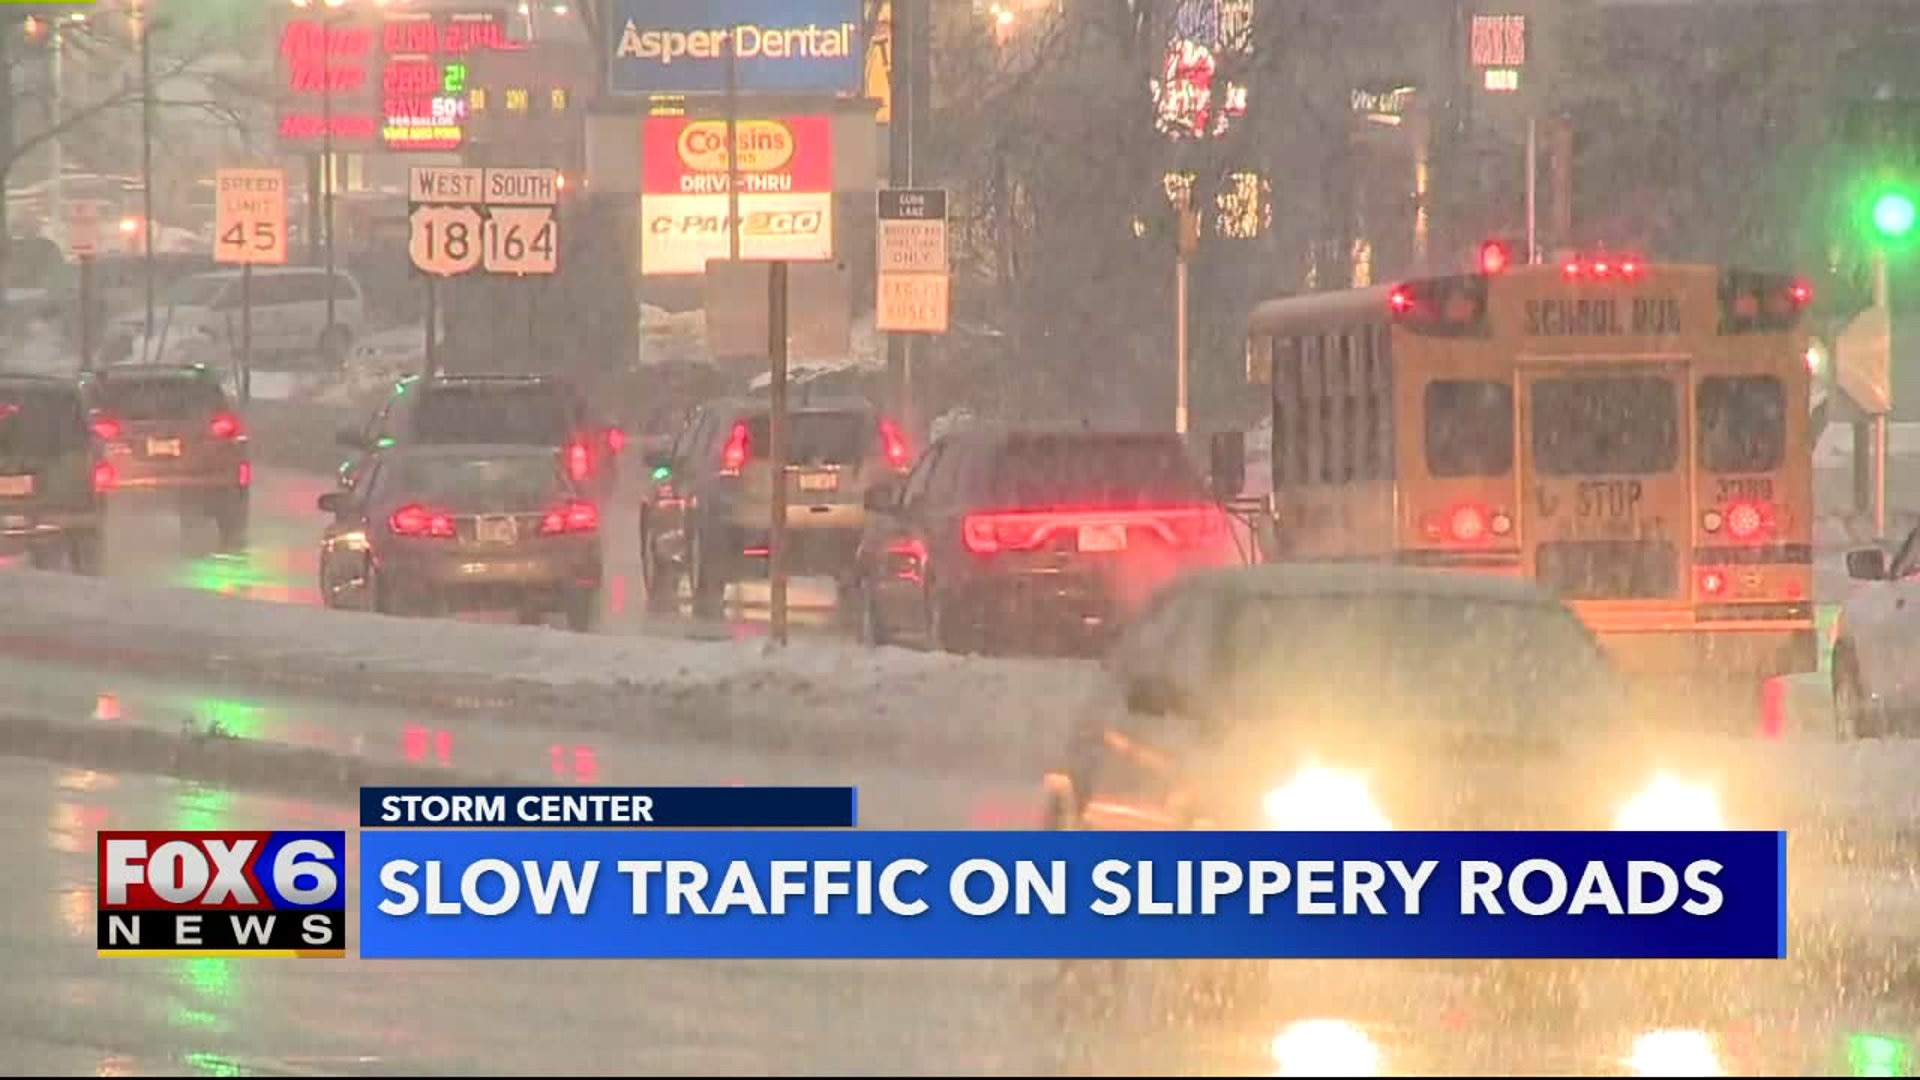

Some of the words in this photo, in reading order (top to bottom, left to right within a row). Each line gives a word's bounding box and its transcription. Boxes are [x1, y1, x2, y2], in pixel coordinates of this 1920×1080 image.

[617, 18, 726, 64] Asper
[736, 23, 851, 57] Dental
[685, 127, 785, 155] Cosins
[220, 177, 279, 193] SPEED
[420, 174, 475, 195] WEST
[491, 173, 550, 198] SOUTH
[680, 173, 792, 193] DRIV-THRU
[227, 200, 272, 214] LIMIT
[221, 221, 276, 251] 45
[423, 219, 470, 261] 18
[488, 222, 554, 262] 164
[1577, 480, 1643, 518] STOP
